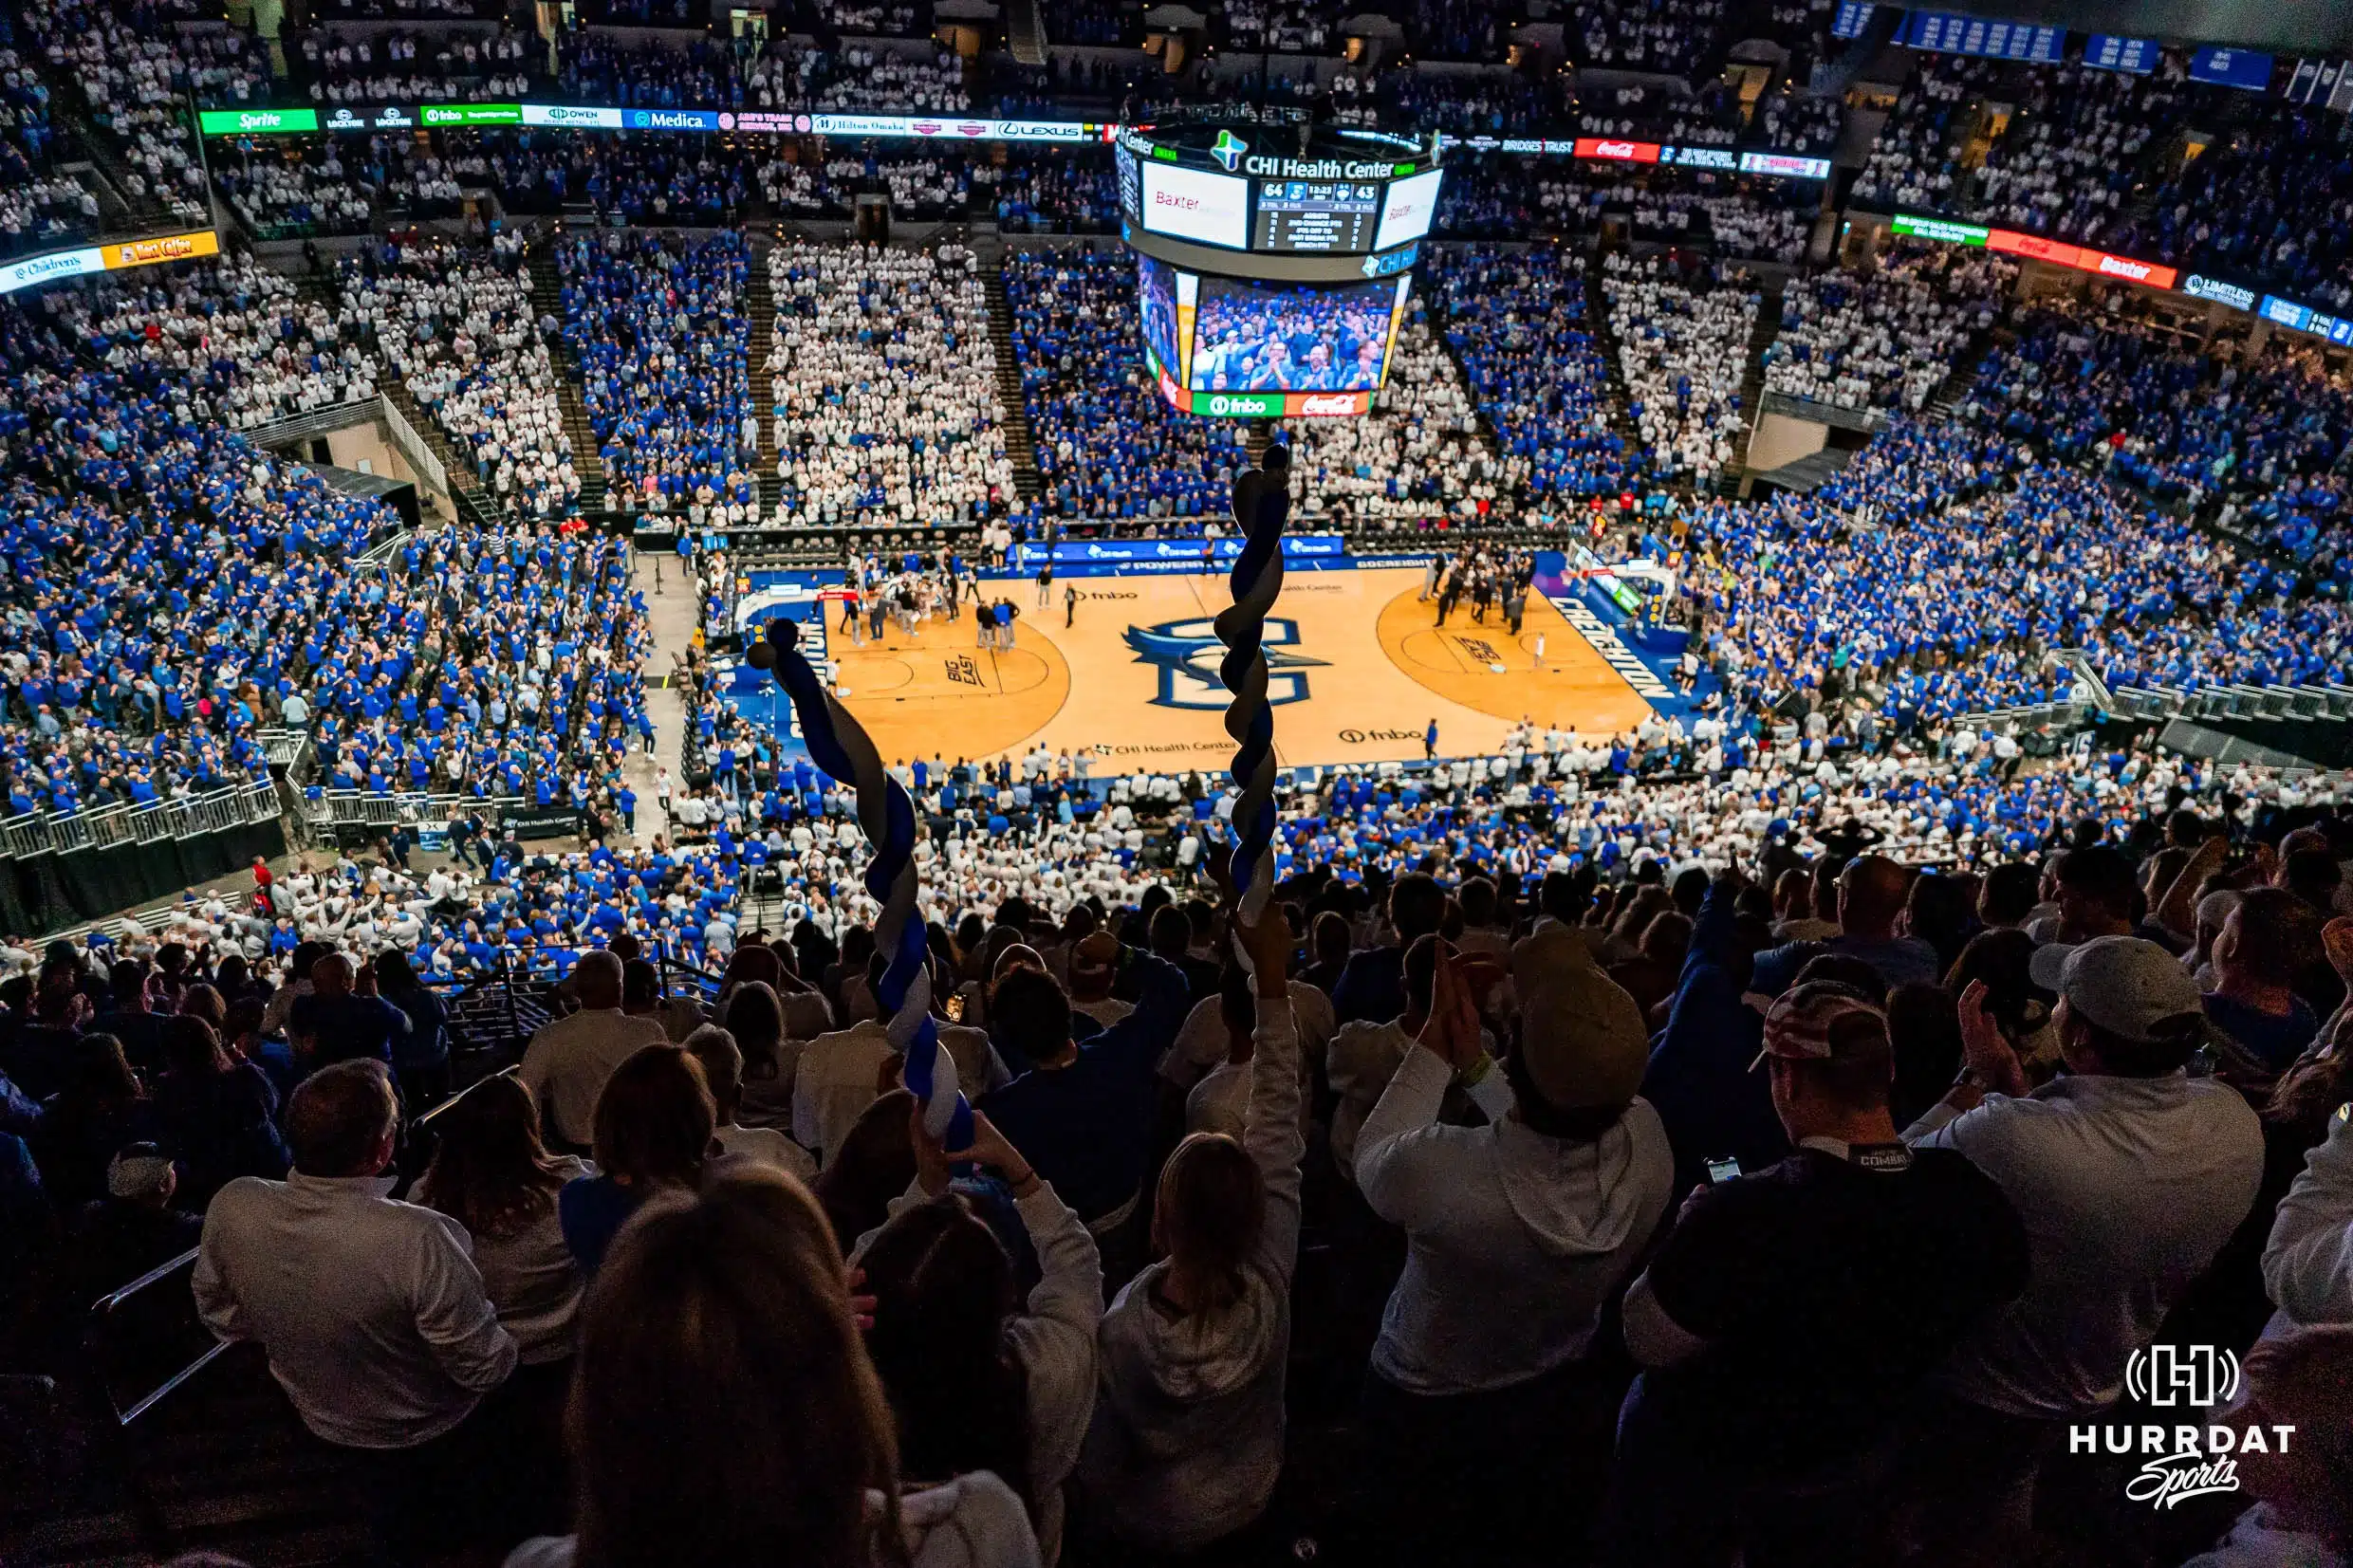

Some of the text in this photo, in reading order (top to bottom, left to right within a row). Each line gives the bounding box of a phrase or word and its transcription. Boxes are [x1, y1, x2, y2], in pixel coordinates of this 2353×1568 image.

[239, 113, 282, 129] Sprite
[438, 110, 462, 120] fnbo
[569, 110, 598, 119] OWEN
[327, 120, 364, 128] LOCKTON
[838, 120, 868, 130] Hilton
[871, 121, 904, 130] Omaha
[1021, 127, 1079, 137] LEXUS
[1502, 138, 1542, 152] BRIDGES
[1544, 140, 1574, 153] TRUST
[1245, 156, 1394, 178] CHI Health Center
[1264, 183, 1284, 197] 64
[1356, 186, 1375, 199] 43
[1156, 191, 1199, 210] Baxter
[2099, 256, 2151, 281] Baxter
[1230, 397, 1267, 414] fnbo
[944, 659, 962, 682] BIG
[957, 654, 977, 685] EAST
[1367, 729, 1422, 741] fnbo
[1115, 745, 1140, 755] CHI
[1144, 743, 1190, 753] Health
